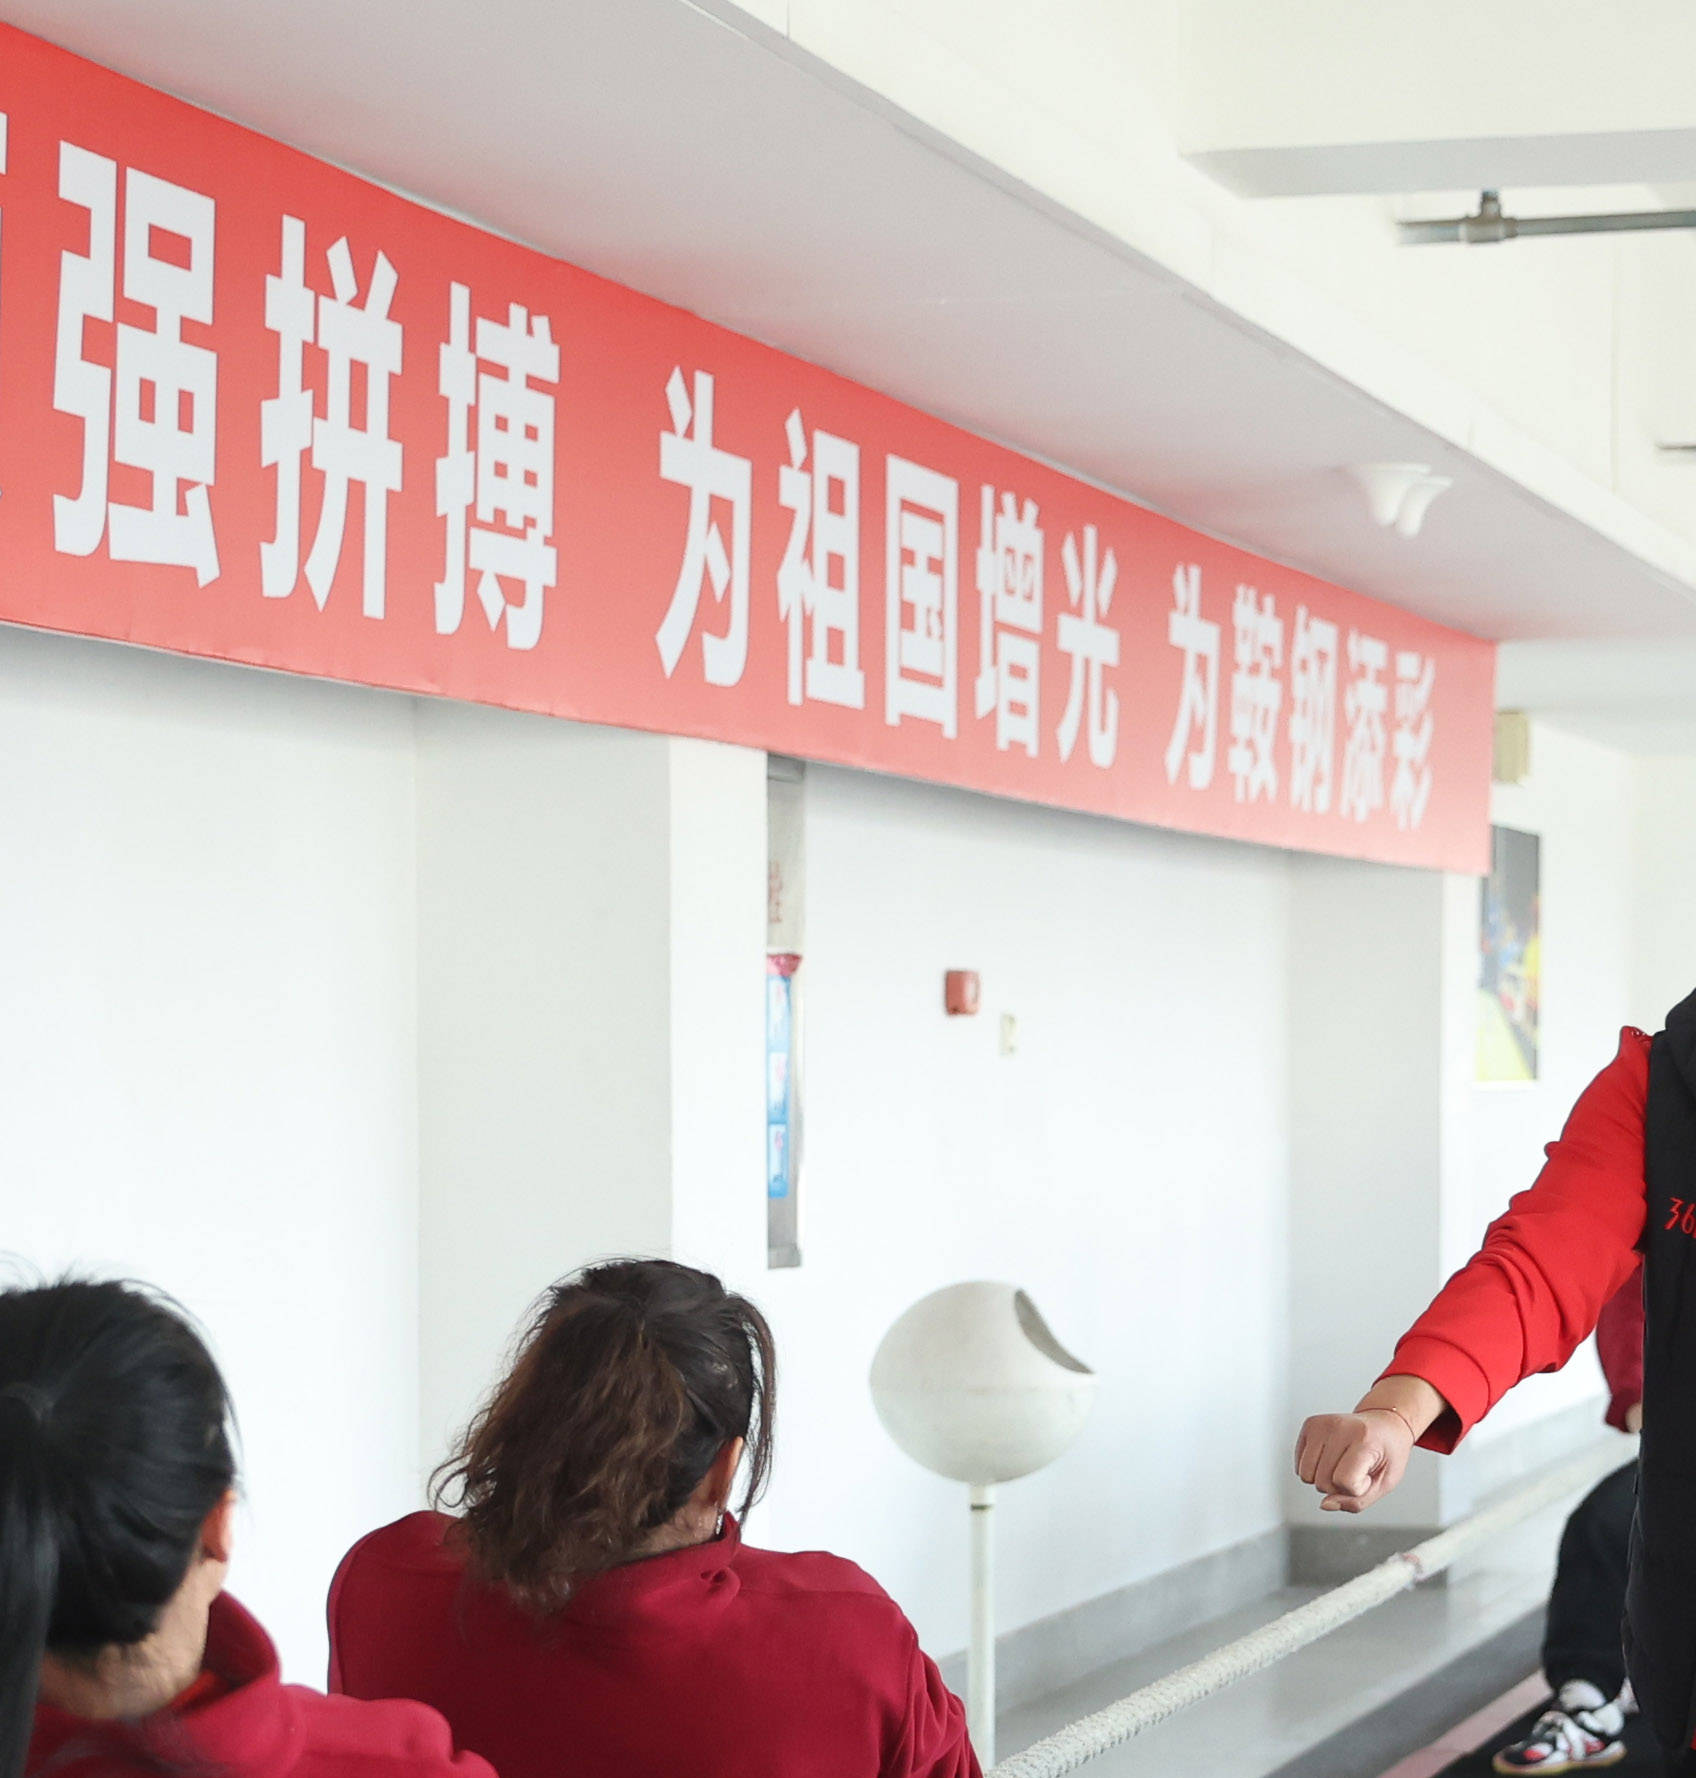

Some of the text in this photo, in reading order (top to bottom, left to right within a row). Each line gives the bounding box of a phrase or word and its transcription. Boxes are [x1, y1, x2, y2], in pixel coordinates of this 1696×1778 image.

[653, 365, 1122, 771] 为祖国增光
[1164, 562, 1436, 833] 为鞍钢添彩
